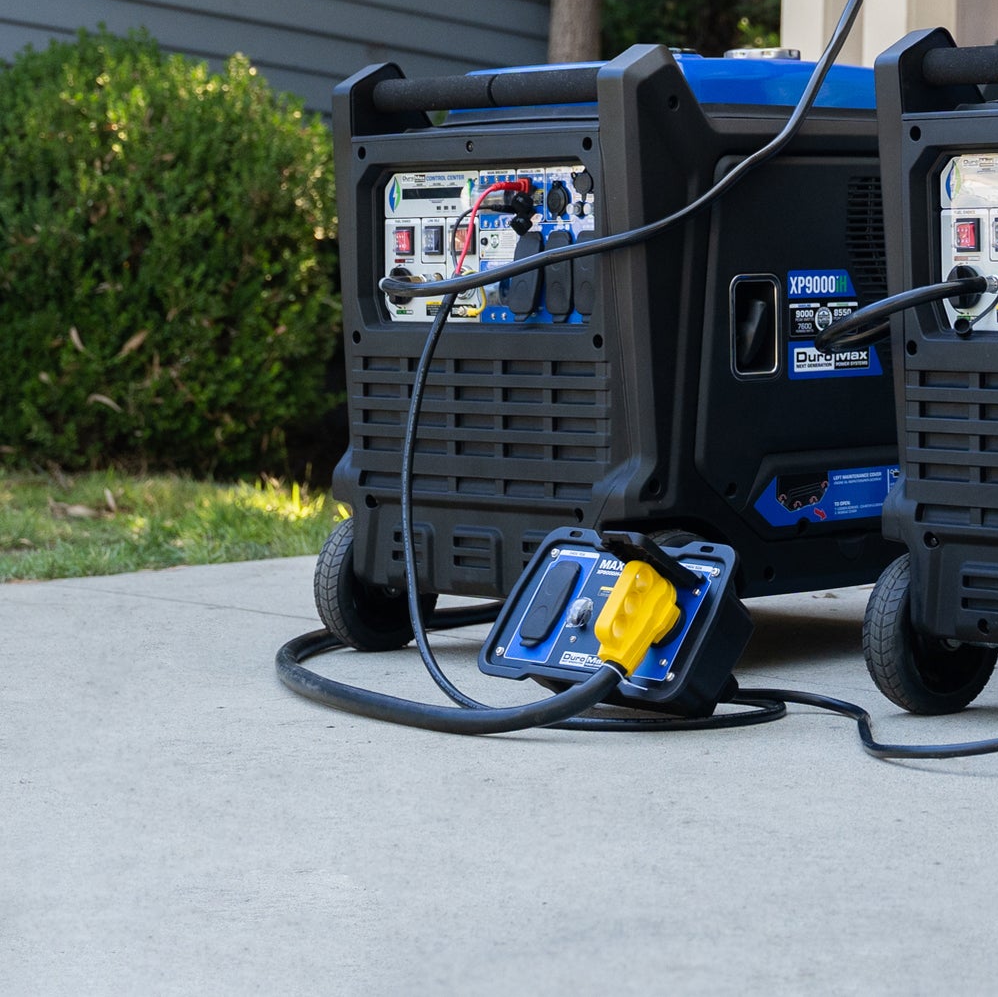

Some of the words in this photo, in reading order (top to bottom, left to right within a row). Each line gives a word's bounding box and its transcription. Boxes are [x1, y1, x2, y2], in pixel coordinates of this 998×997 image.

[426, 174, 446, 182] CONTROL
[790, 275, 847, 295] XP9000iH
[795, 309, 814, 318] 9000
